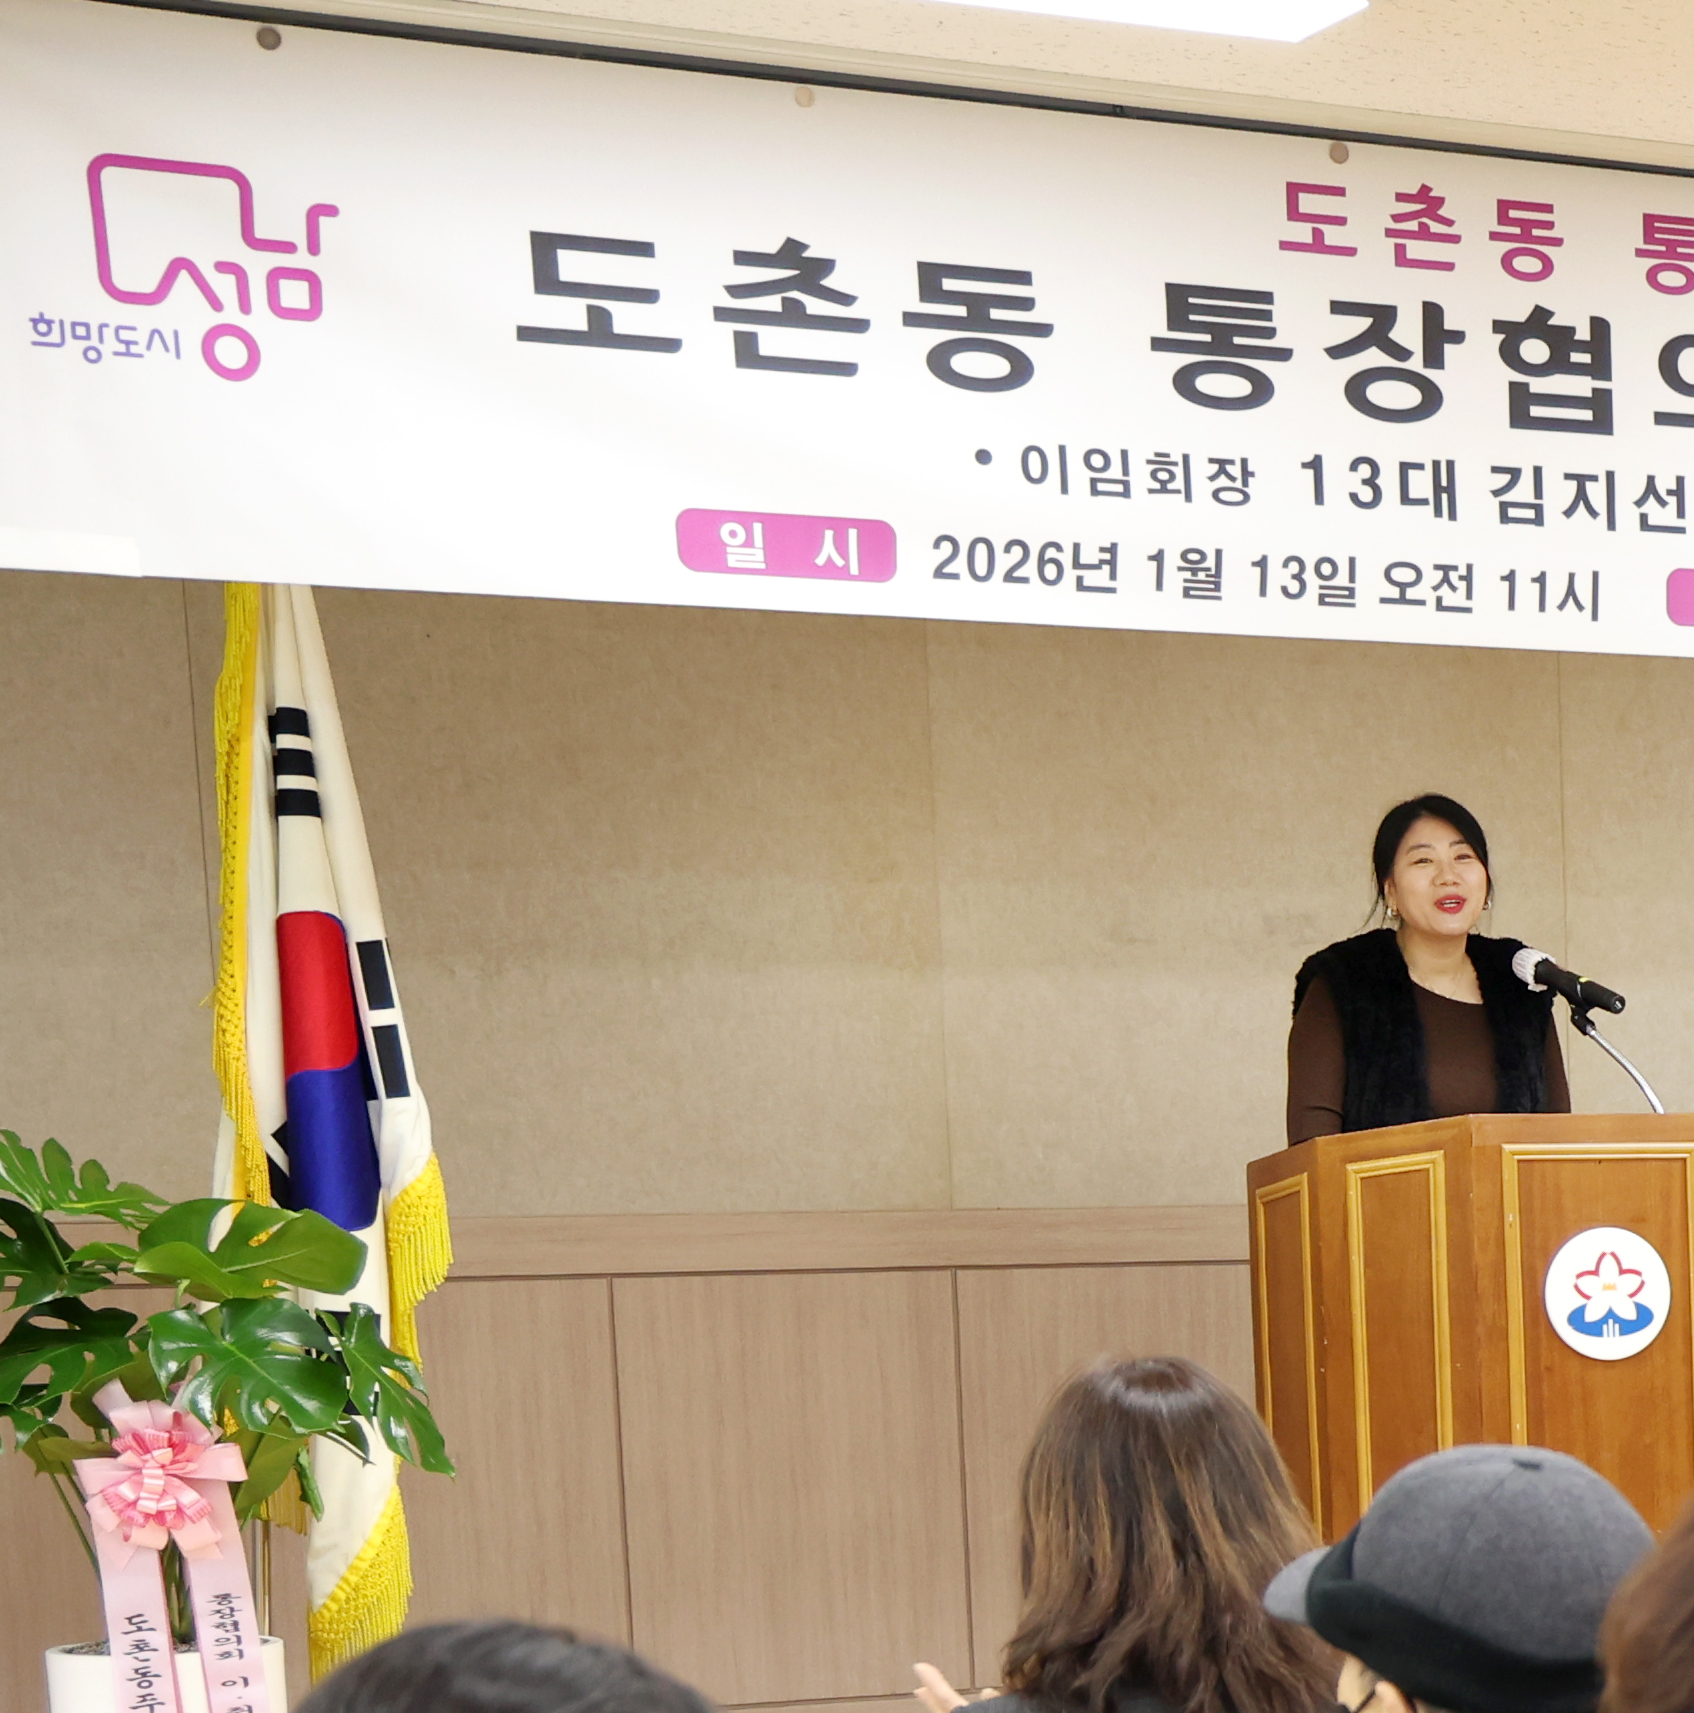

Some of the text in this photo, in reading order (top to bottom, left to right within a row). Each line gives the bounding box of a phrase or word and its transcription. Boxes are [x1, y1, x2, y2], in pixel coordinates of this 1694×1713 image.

[1279, 181, 1564, 282] 도촌동
[29, 312, 180, 363] 희망도시
[516, 231, 1054, 392] 도촌동
[1021, 445, 1686, 534] 이임회장 13대 김지선
[933, 535, 1599, 621] 2026년 1월 13일 오전 11시
